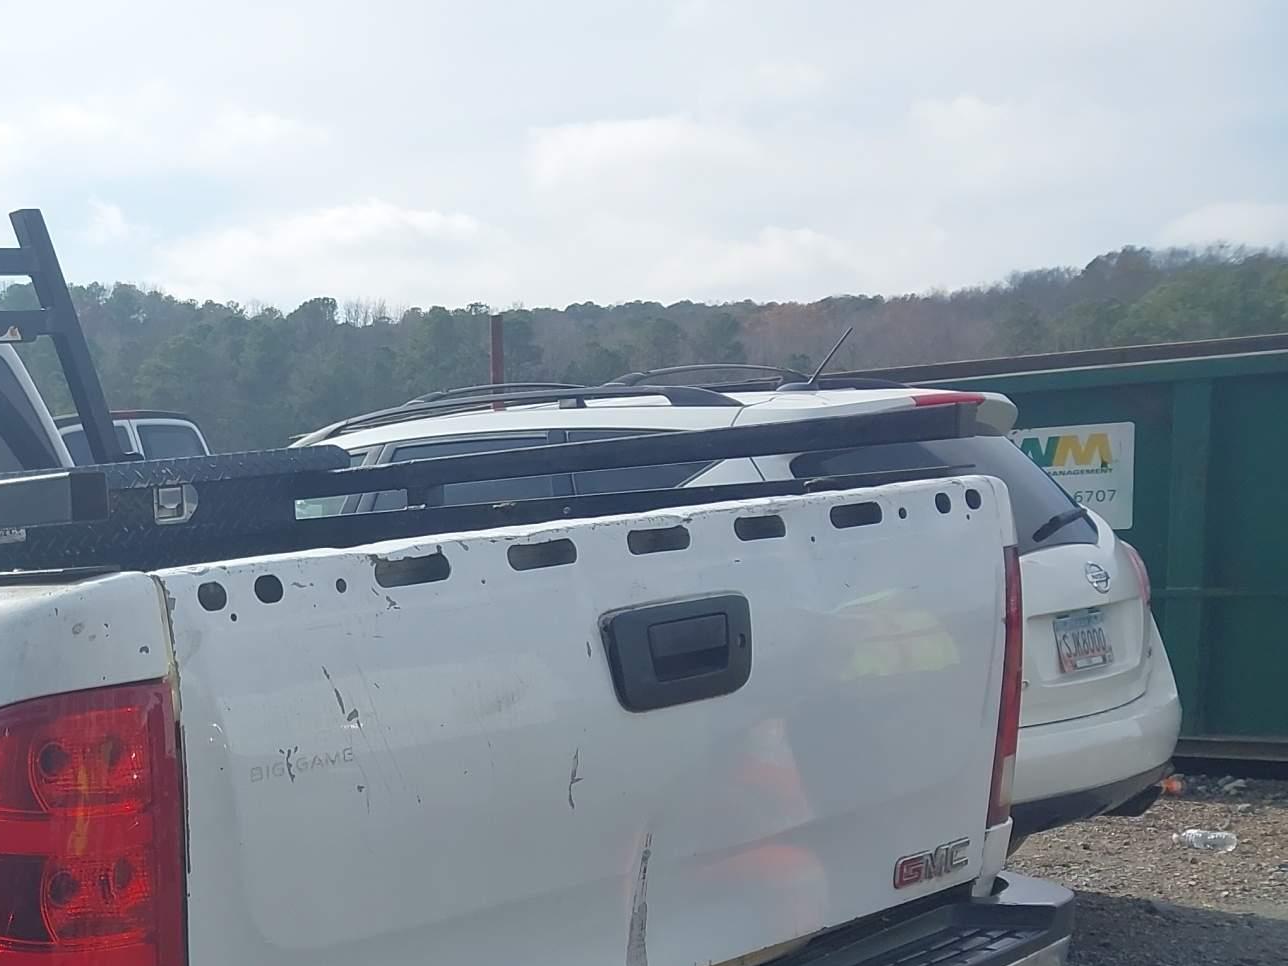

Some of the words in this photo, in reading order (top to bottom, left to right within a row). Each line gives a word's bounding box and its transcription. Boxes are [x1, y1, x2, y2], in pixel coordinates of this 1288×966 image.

[1073, 489, 1117, 503] 6707
[250, 761, 285, 783] BIG
[295, 746, 354, 772] GAME
[893, 836, 970, 889] GMC
